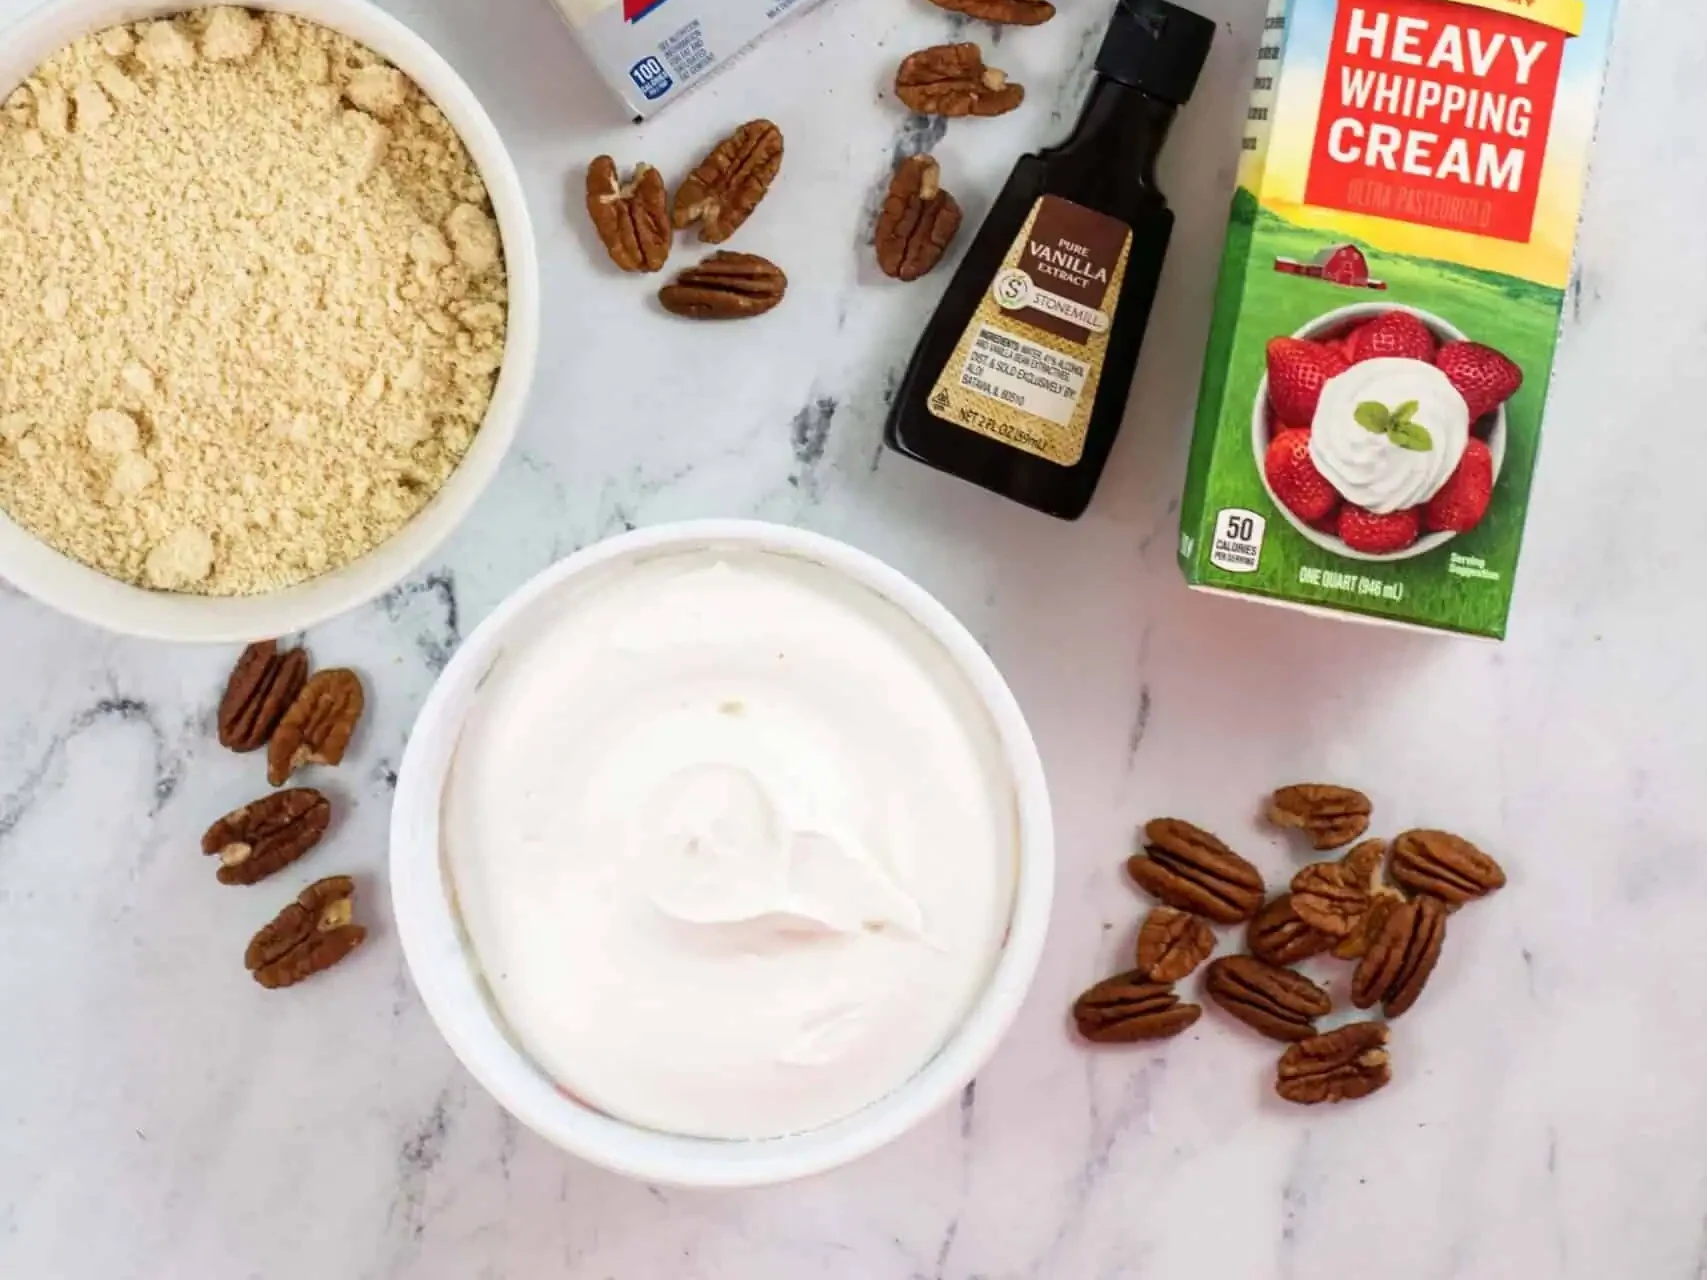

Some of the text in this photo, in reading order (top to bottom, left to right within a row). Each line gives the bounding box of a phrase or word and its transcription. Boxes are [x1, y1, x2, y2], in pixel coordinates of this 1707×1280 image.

[1346, 8, 1548, 85] HEAVY
[633, 59, 661, 84] 100
[1341, 65, 1532, 139] WHIPPING
[1328, 117, 1525, 193] CREAM
[1058, 238, 1091, 257] PURE
[1031, 240, 1107, 284] VANILLA
[1038, 262, 1090, 288] EXTRACT
[1006, 279, 1021, 298] S
[1033, 292, 1101, 328] STONEMILL
[1227, 516, 1254, 541] 50
[1299, 565, 1322, 586] ONE
[1321, 570, 1358, 592] QUART
